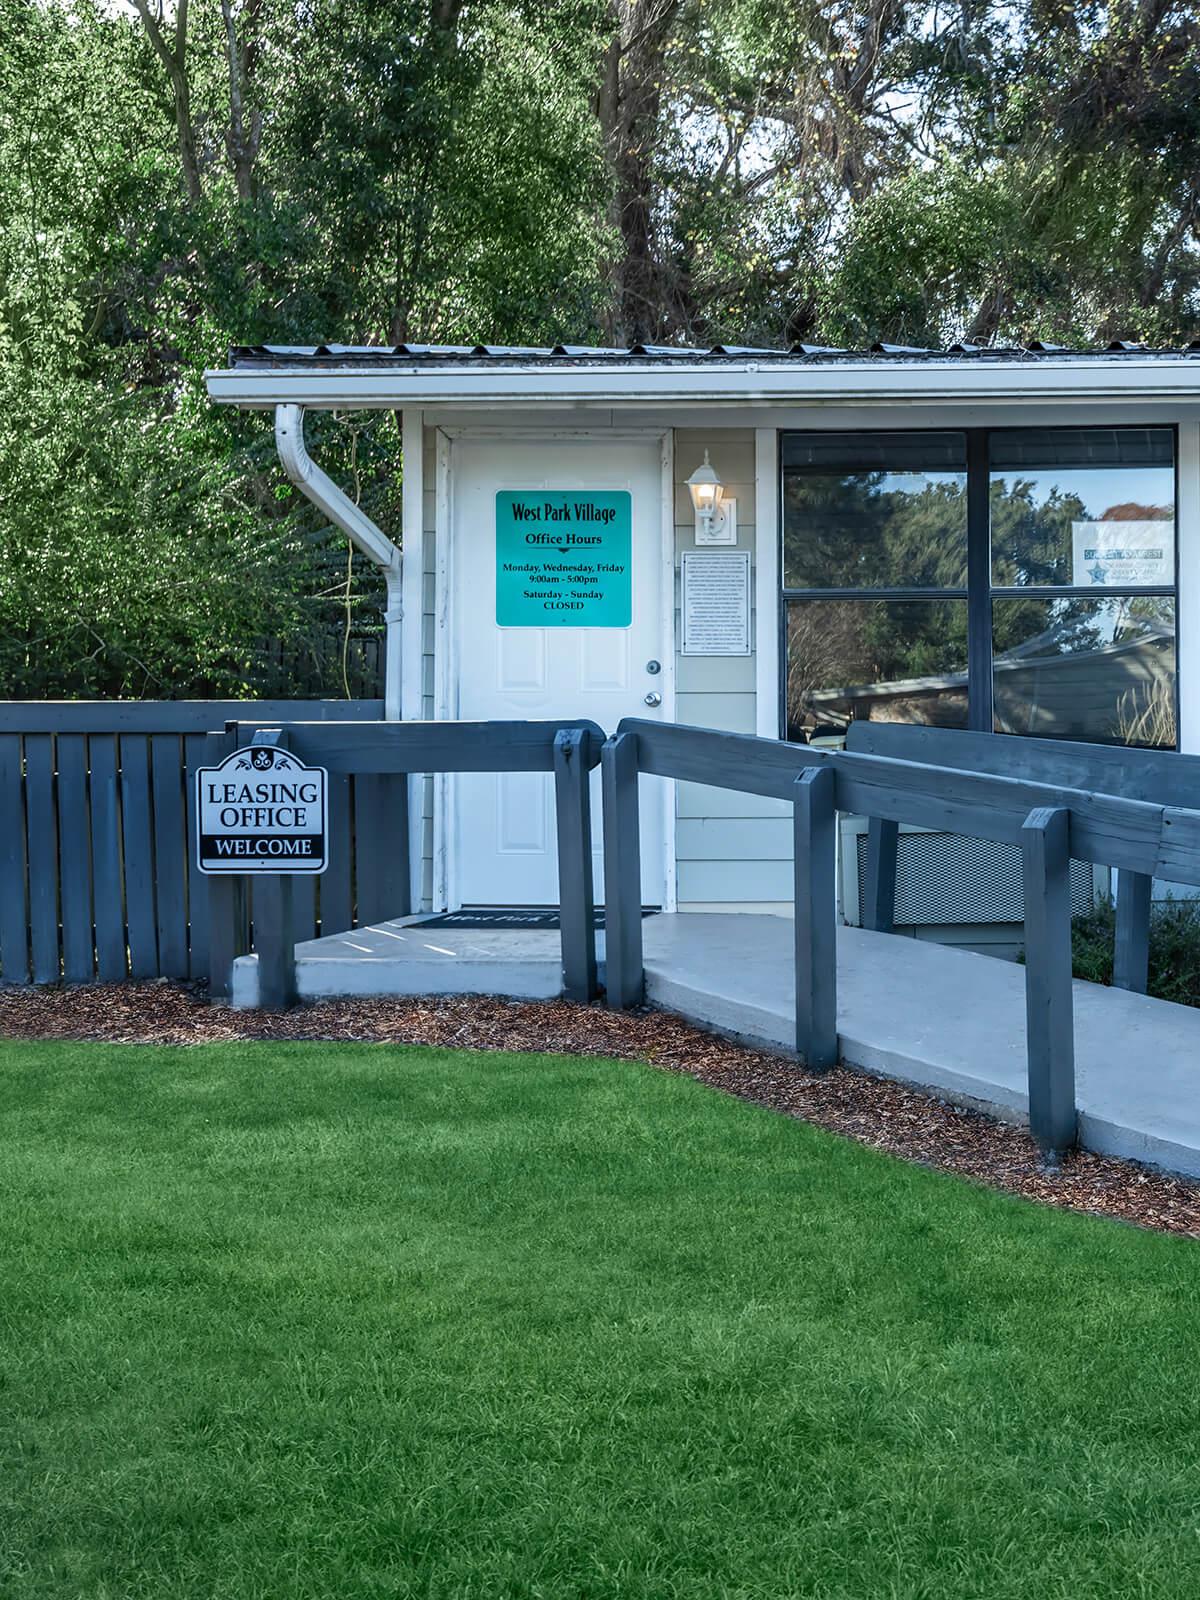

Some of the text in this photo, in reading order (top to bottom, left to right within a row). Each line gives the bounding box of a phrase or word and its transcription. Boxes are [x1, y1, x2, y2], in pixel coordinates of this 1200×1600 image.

[512, 503, 616, 525] West Park Village
[525, 533, 602, 544] Office Hours
[503, 564, 625, 574] Monday, Wednesday, Friday
[529, 575, 560, 584] 9:00am
[567, 575, 599, 585] 5:00pm
[523, 590, 563, 600] Saturday
[570, 590, 604, 600] Sunday
[543, 602, 584, 610] CLOSED
[208, 783, 318, 804] LEASING
[220, 807, 307, 827] OFFICE
[215, 839, 312, 855] WELCOME
